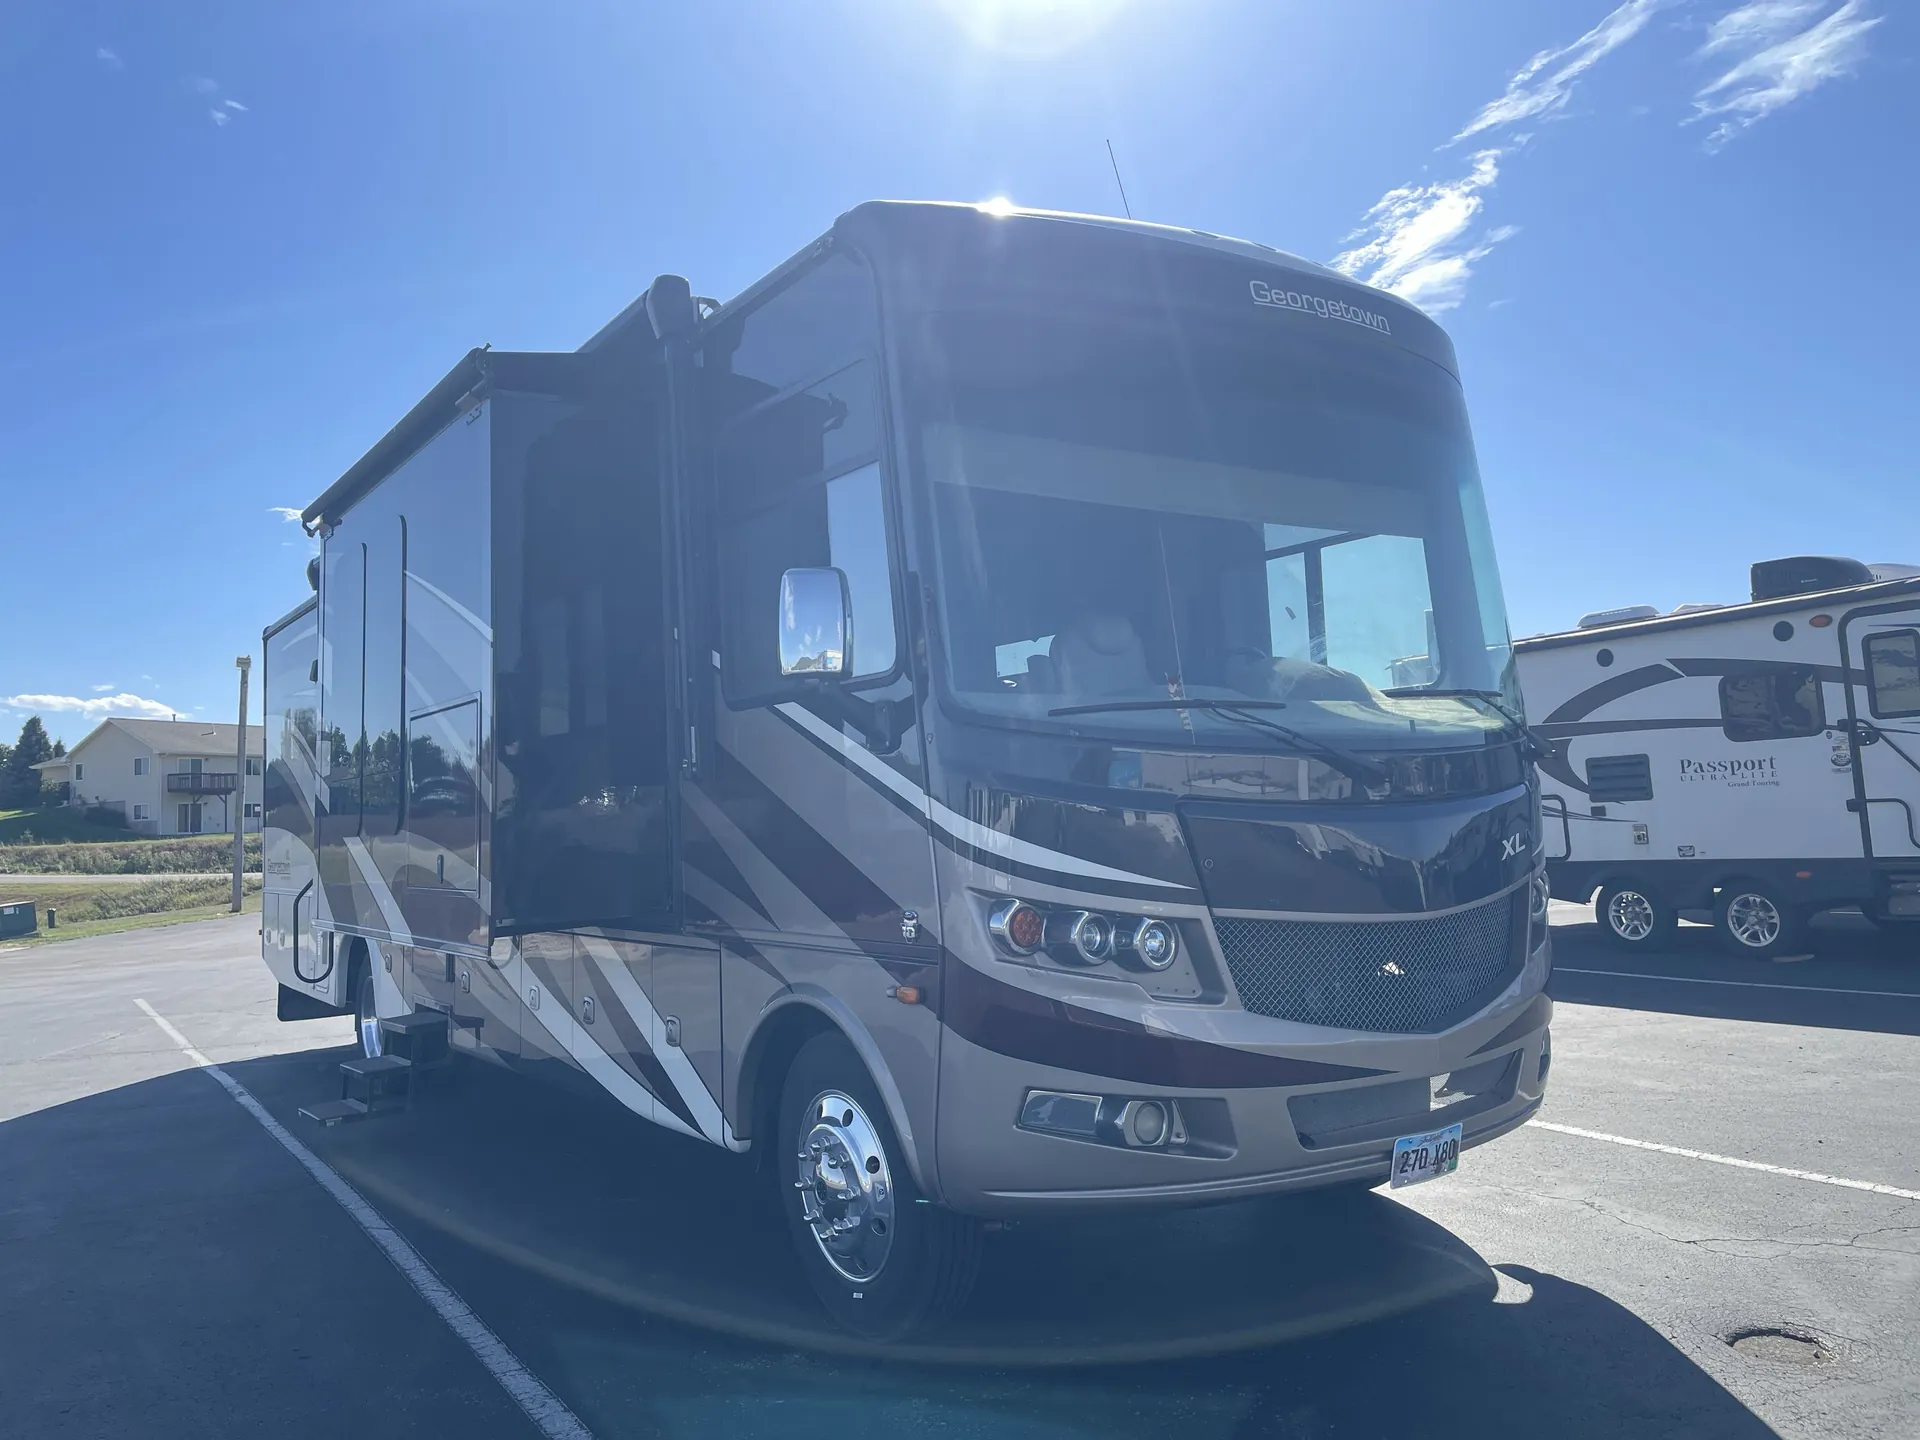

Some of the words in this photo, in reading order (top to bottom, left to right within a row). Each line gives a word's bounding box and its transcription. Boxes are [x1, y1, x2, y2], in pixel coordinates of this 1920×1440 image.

[1250, 280, 1390, 333] Georgetown
[1680, 756, 1776, 776] Passport
[1680, 774, 1727, 782] ULTRA
[1741, 770, 1778, 779] LITE
[1501, 832, 1526, 861] XL
[1433, 1138, 1456, 1166] X80
